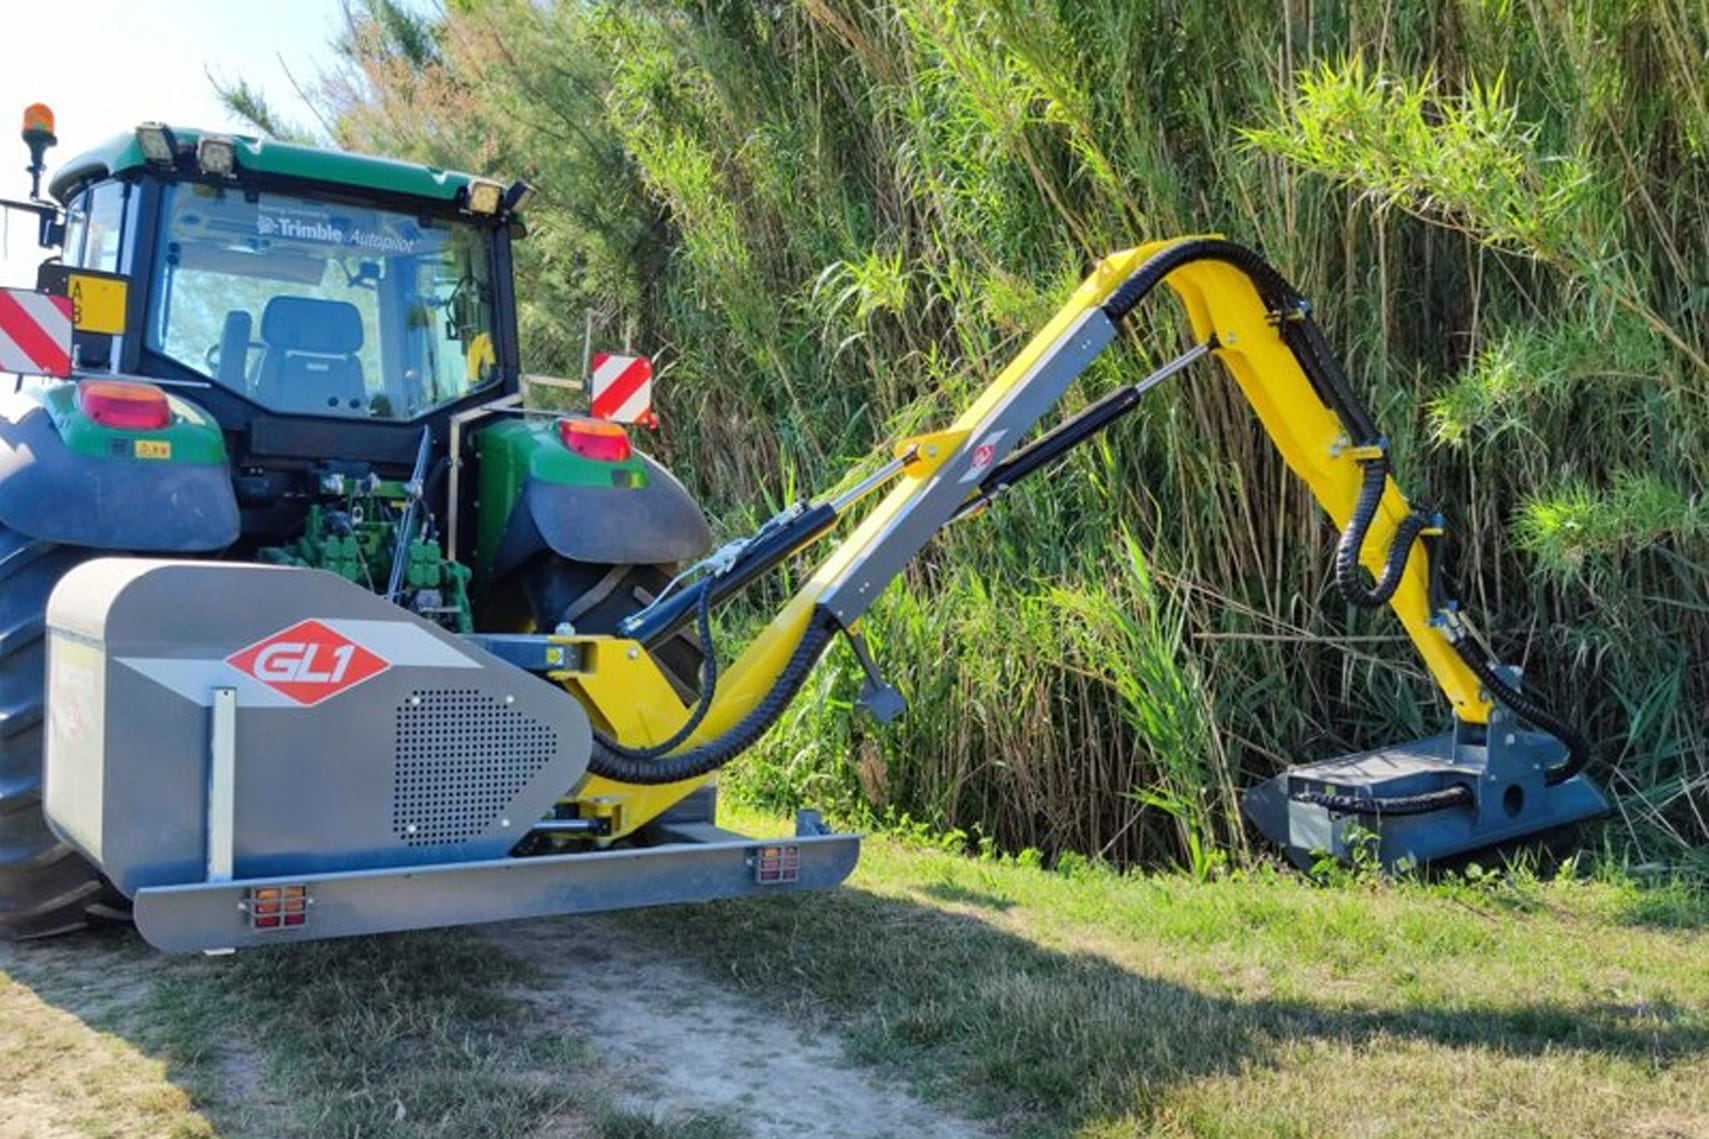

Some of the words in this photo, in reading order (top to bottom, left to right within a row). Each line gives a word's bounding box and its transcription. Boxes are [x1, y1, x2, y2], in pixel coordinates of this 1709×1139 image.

[278, 218, 342, 243] Trimble
[350, 229, 415, 252] Autopilot
[253, 641, 355, 683] GL1
